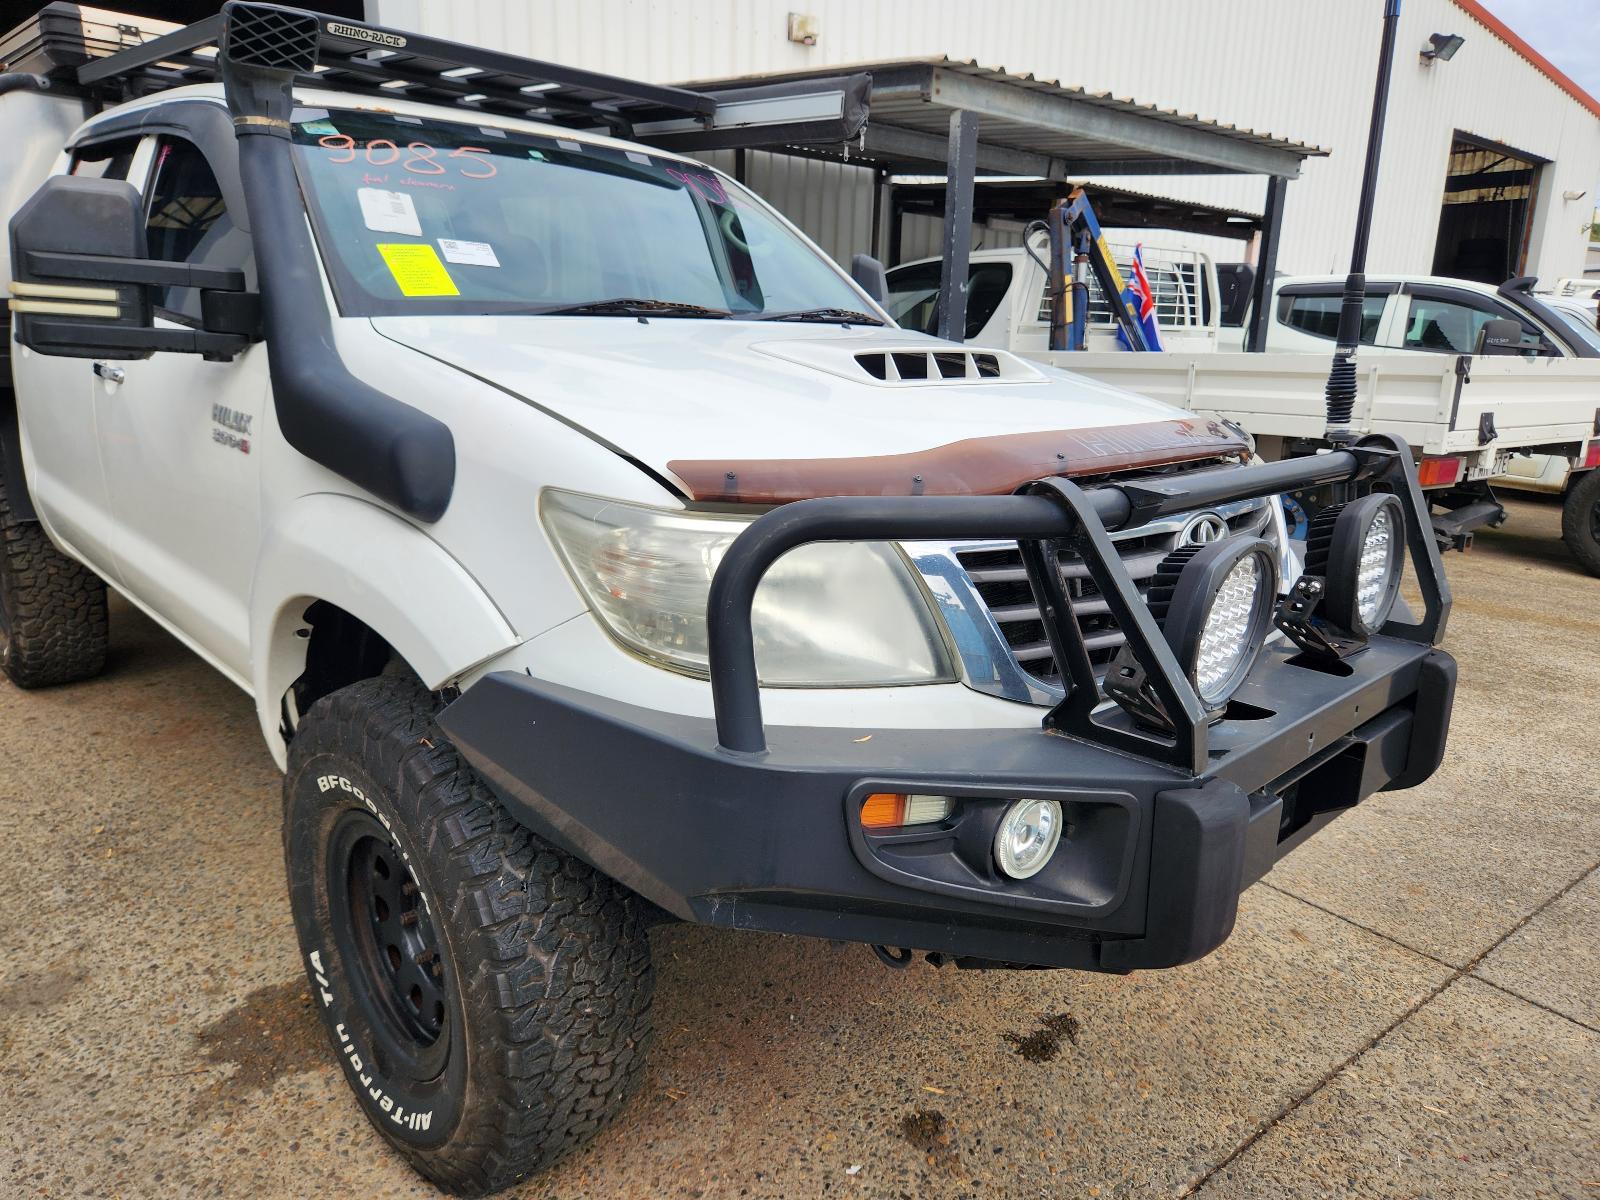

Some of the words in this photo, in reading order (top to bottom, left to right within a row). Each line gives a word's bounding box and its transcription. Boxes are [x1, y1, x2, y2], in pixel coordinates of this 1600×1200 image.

[333, 24, 400, 46] RHINO-RACK
[318, 133, 498, 179] 9085
[309, 950, 334, 1008] T/A
[336, 1023, 433, 1131] All-Terrain
